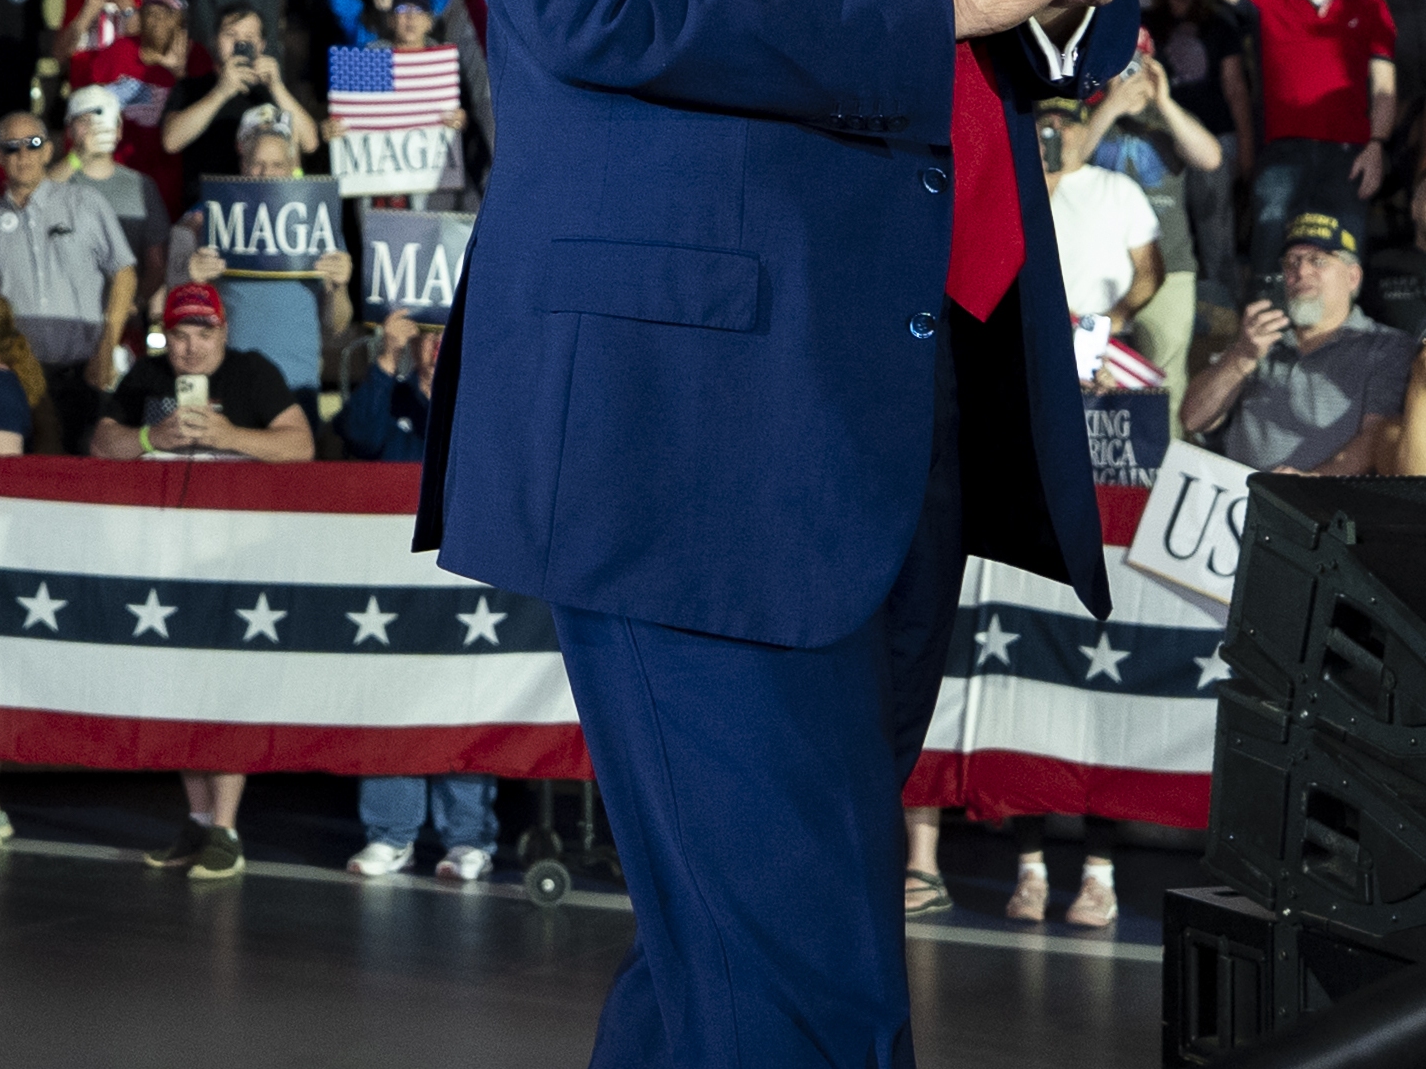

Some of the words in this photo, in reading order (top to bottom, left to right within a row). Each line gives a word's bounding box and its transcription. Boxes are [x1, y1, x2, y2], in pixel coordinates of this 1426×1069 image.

[338, 127, 461, 176] MAGA
[204, 199, 339, 257] MAGA
[365, 240, 465, 308] MA
[1085, 408, 1132, 439] KING
[1090, 438, 1137, 467] RICA
[1163, 470, 1250, 578] US
